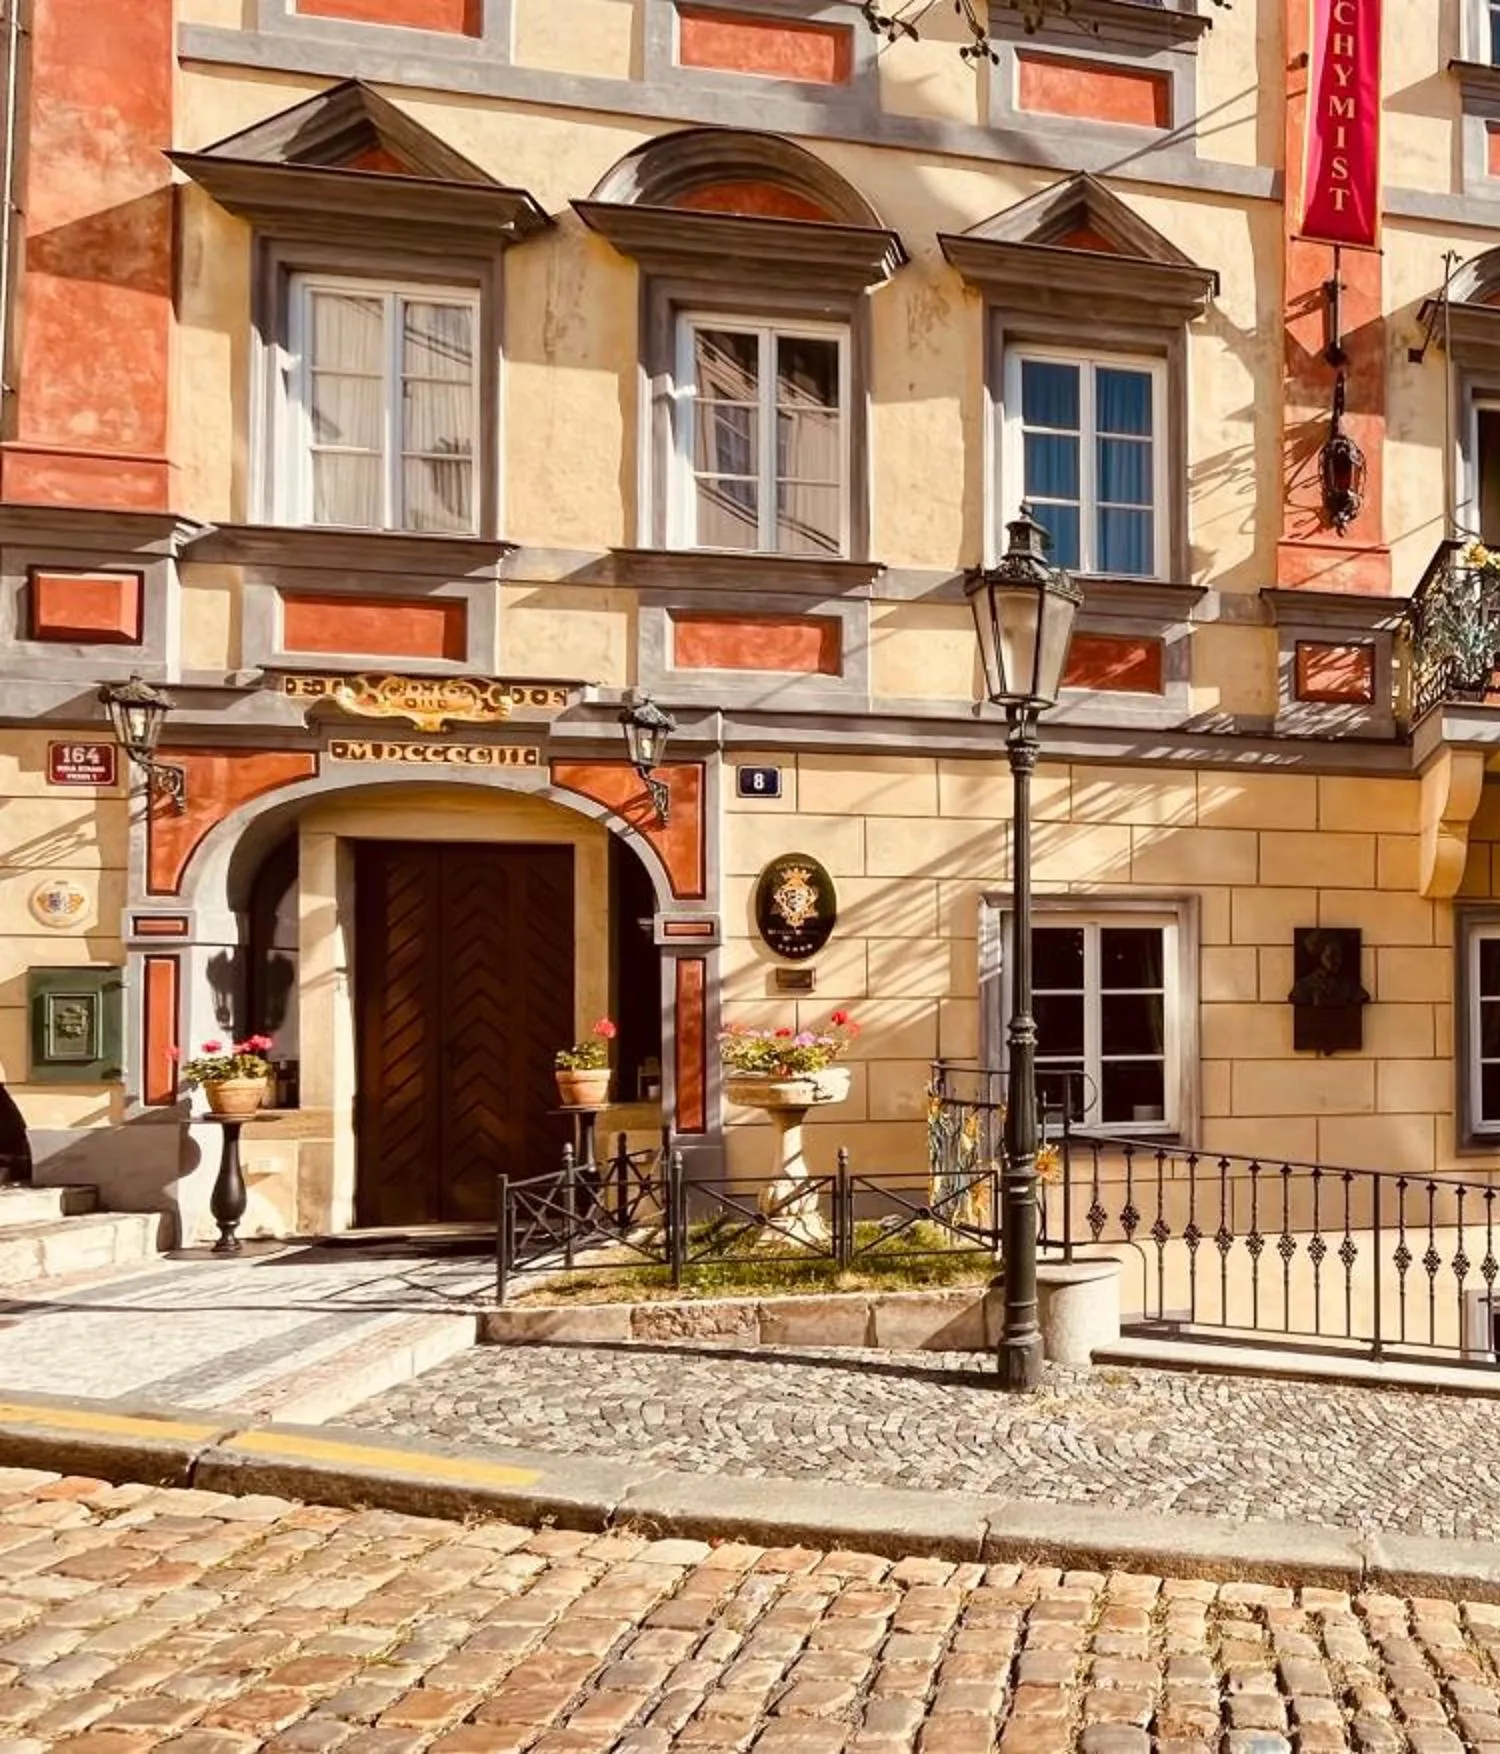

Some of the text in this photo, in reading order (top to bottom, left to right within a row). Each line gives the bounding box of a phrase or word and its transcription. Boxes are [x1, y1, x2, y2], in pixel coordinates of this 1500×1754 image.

[1329, 2, 1355, 211] CHYMIST
[62, 747, 100, 765] 164
[753, 773, 765, 790] 8
